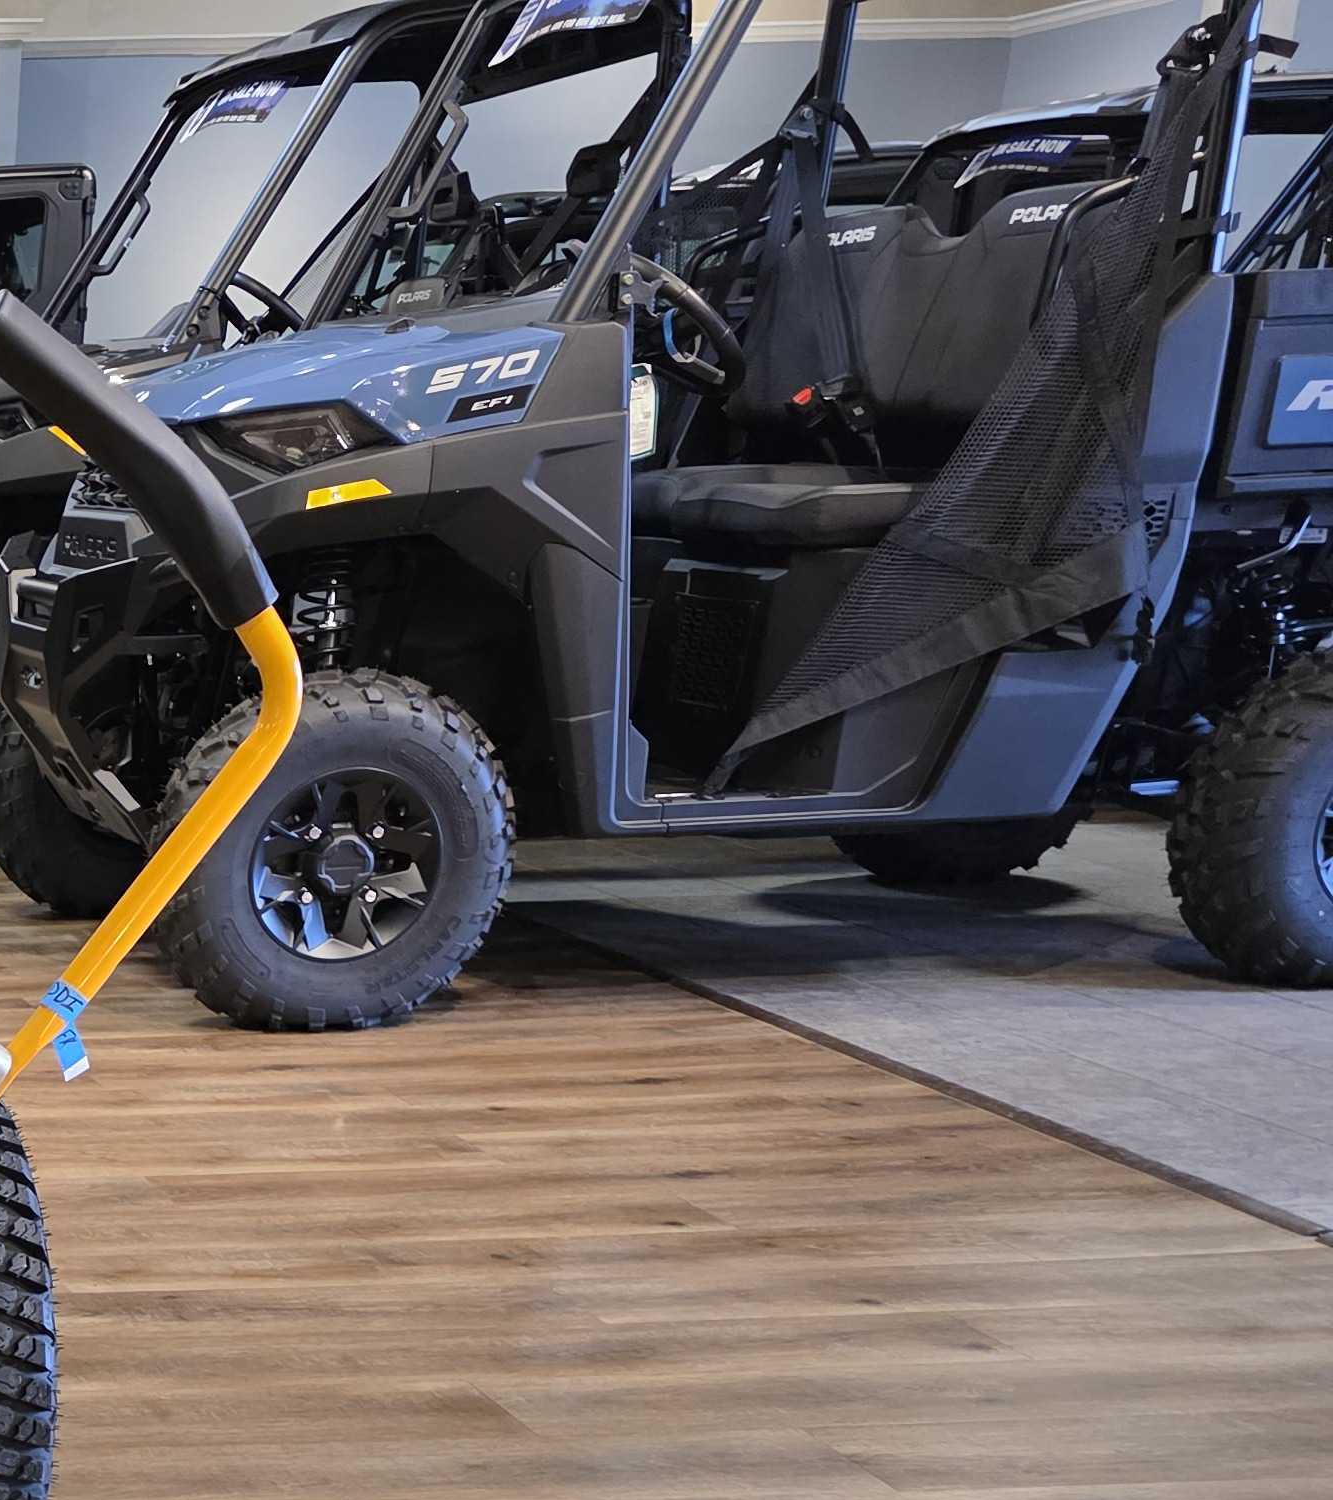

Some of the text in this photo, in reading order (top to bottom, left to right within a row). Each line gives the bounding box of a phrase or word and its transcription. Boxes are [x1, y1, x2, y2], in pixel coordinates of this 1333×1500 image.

[1006, 138, 1040, 154] SALE
[1035, 139, 1071, 154] NOW
[470, 395, 514, 411] EFI
